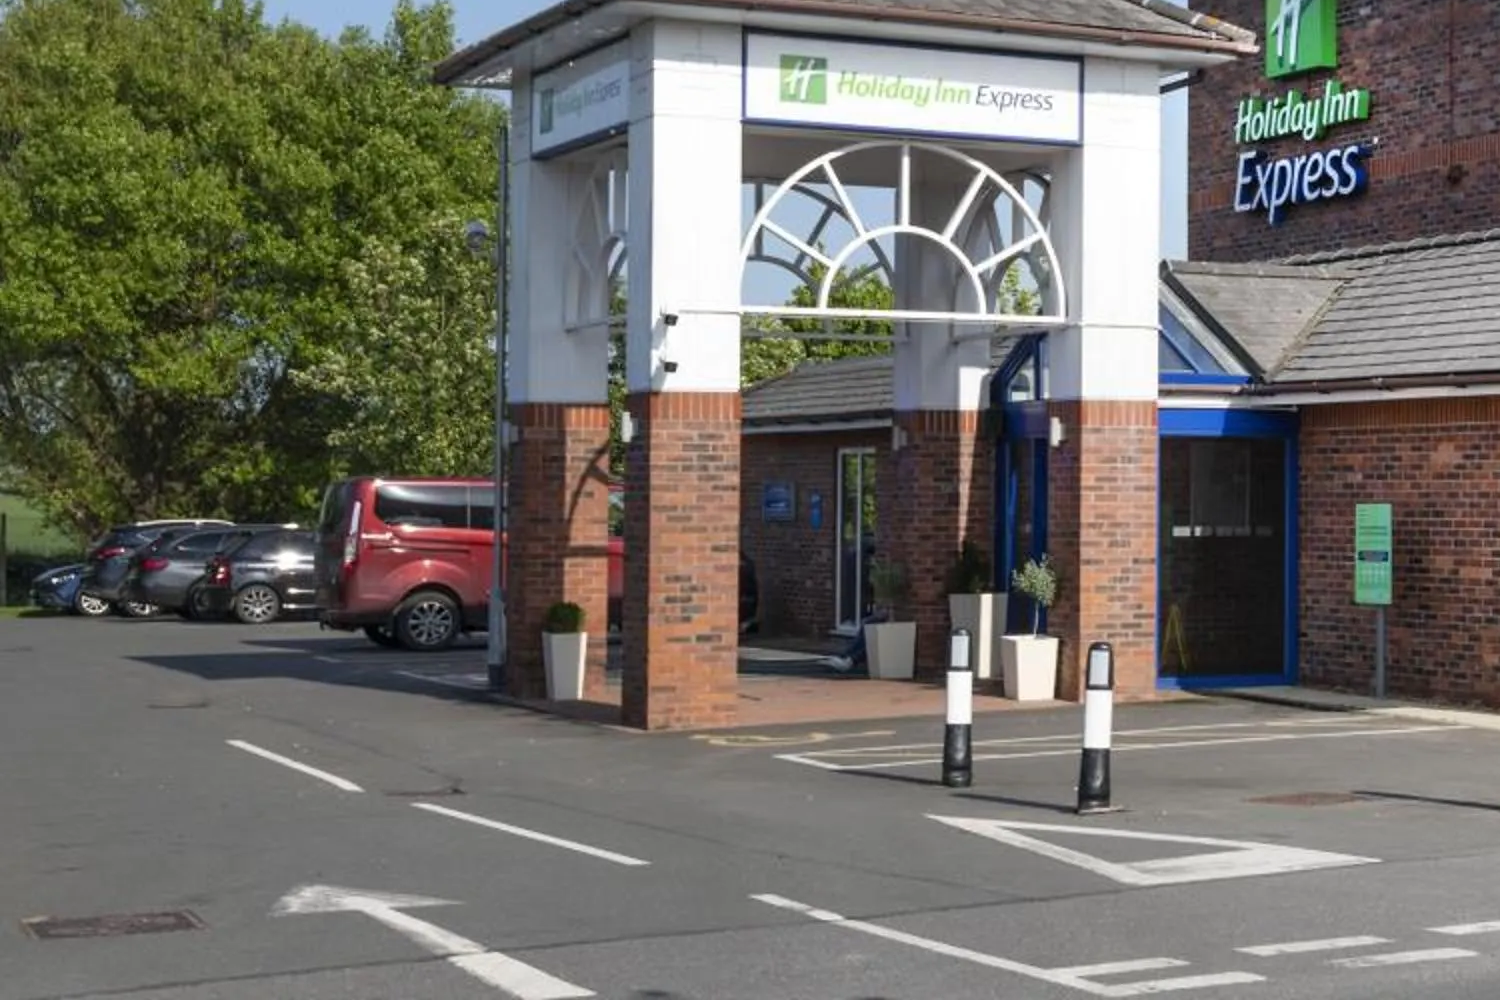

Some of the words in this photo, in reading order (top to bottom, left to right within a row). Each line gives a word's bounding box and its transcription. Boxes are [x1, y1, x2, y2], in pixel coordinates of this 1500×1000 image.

[837, 70, 930, 108] Holiday
[935, 76, 971, 105] Inn
[975, 85, 1053, 112] Express
[1235, 90, 1321, 144] Holiday
[1322, 79, 1360, 126] Inn
[1233, 146, 1360, 226] Express
